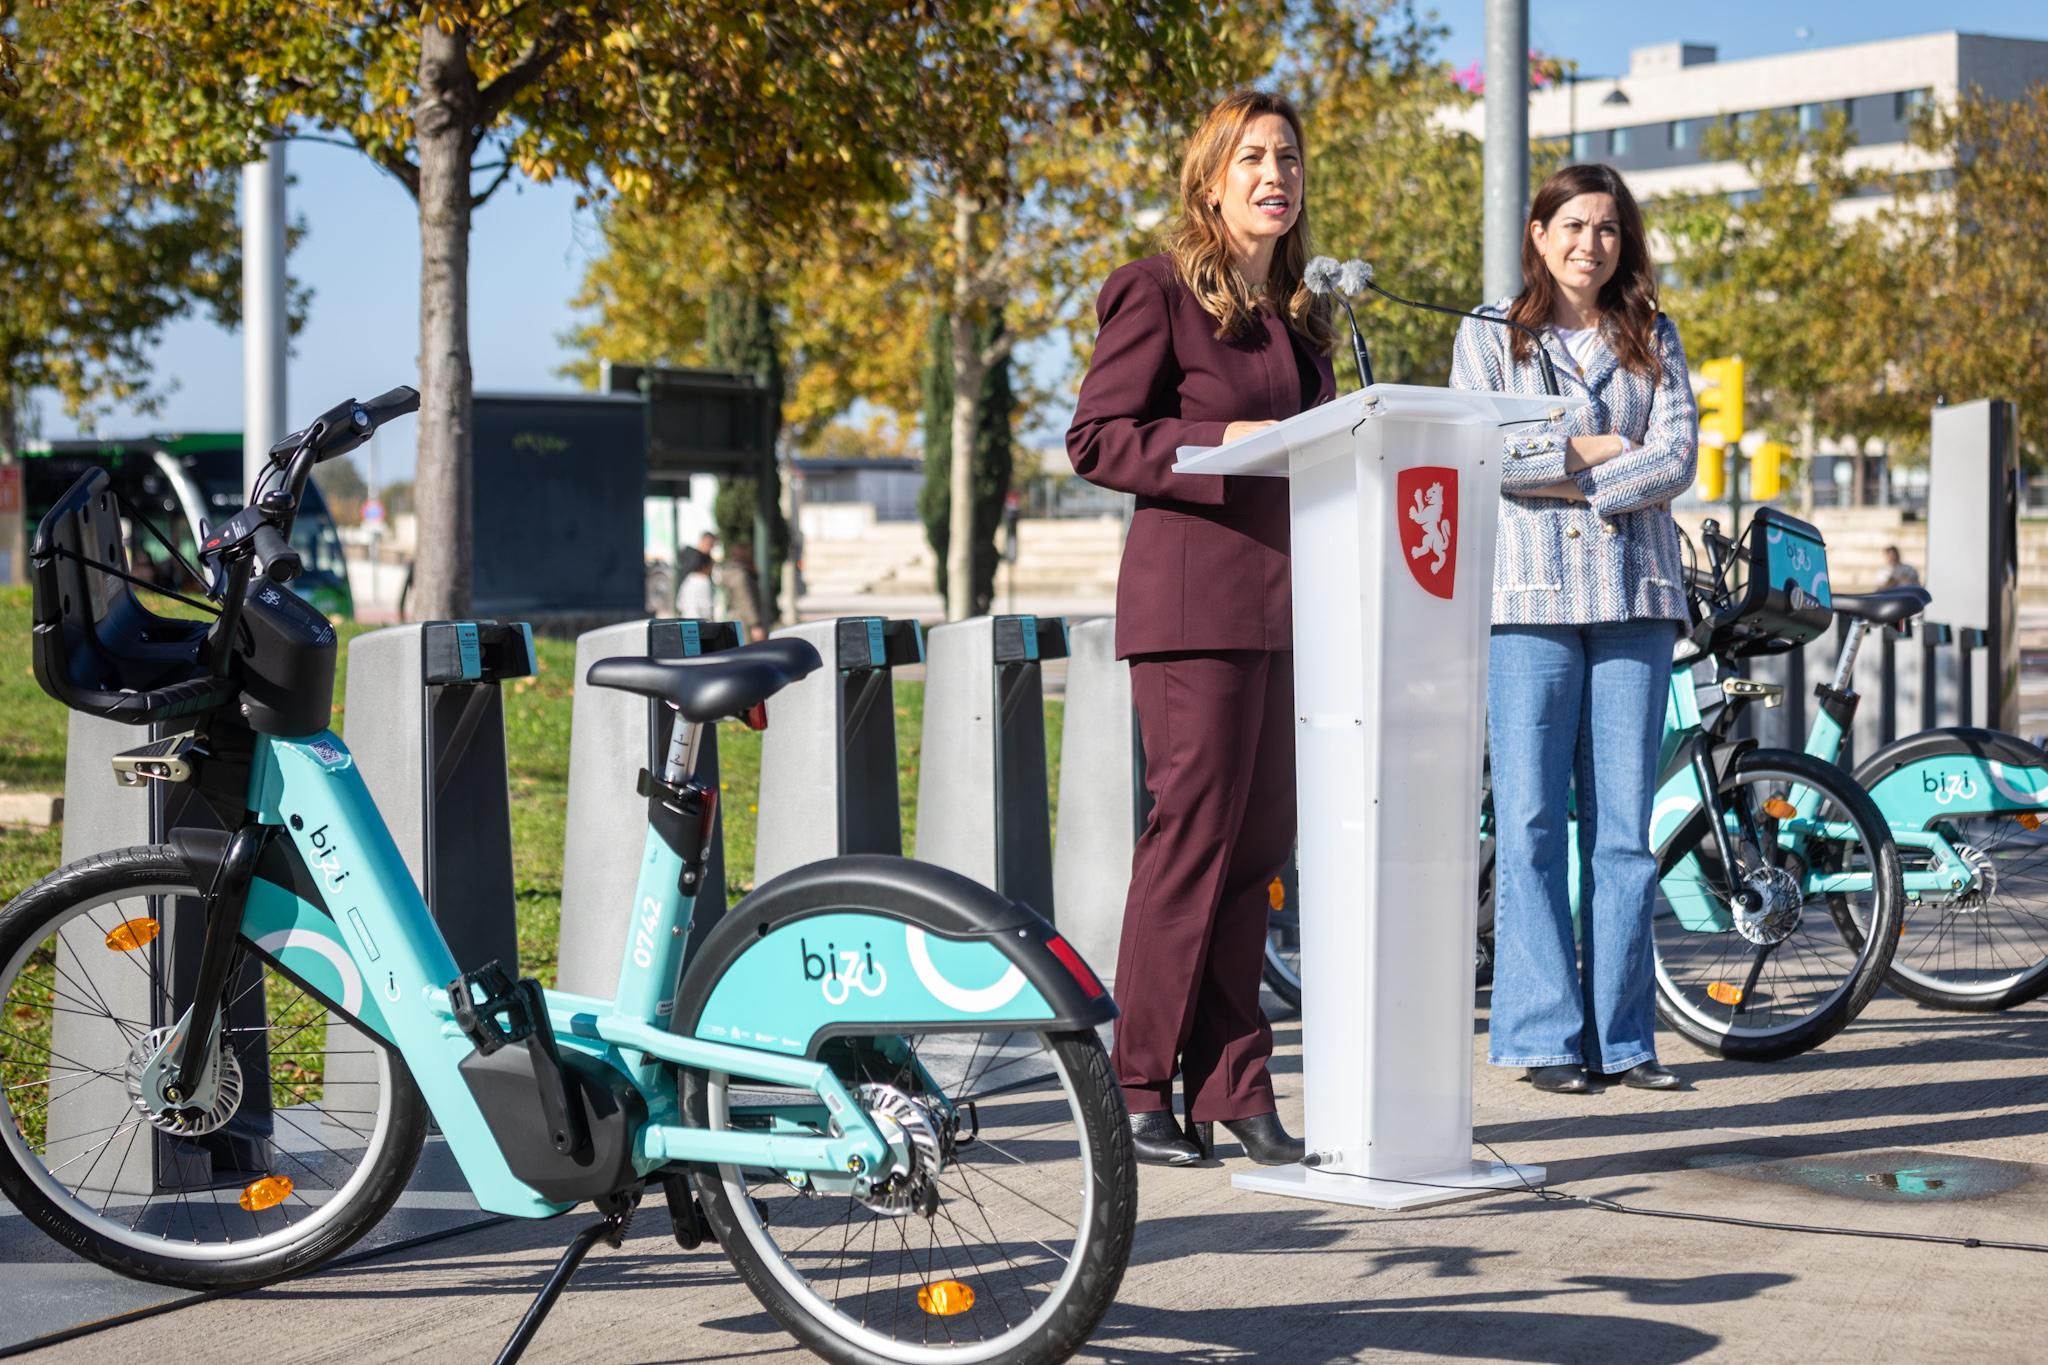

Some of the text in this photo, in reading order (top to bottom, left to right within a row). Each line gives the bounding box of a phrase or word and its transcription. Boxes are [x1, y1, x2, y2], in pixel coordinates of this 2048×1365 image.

[674, 753, 680, 762] 2
[1923, 770, 1978, 804] bizi
[309, 824, 350, 894] bizi
[633, 896, 662, 968] 0742
[801, 937, 887, 1005] bizi
